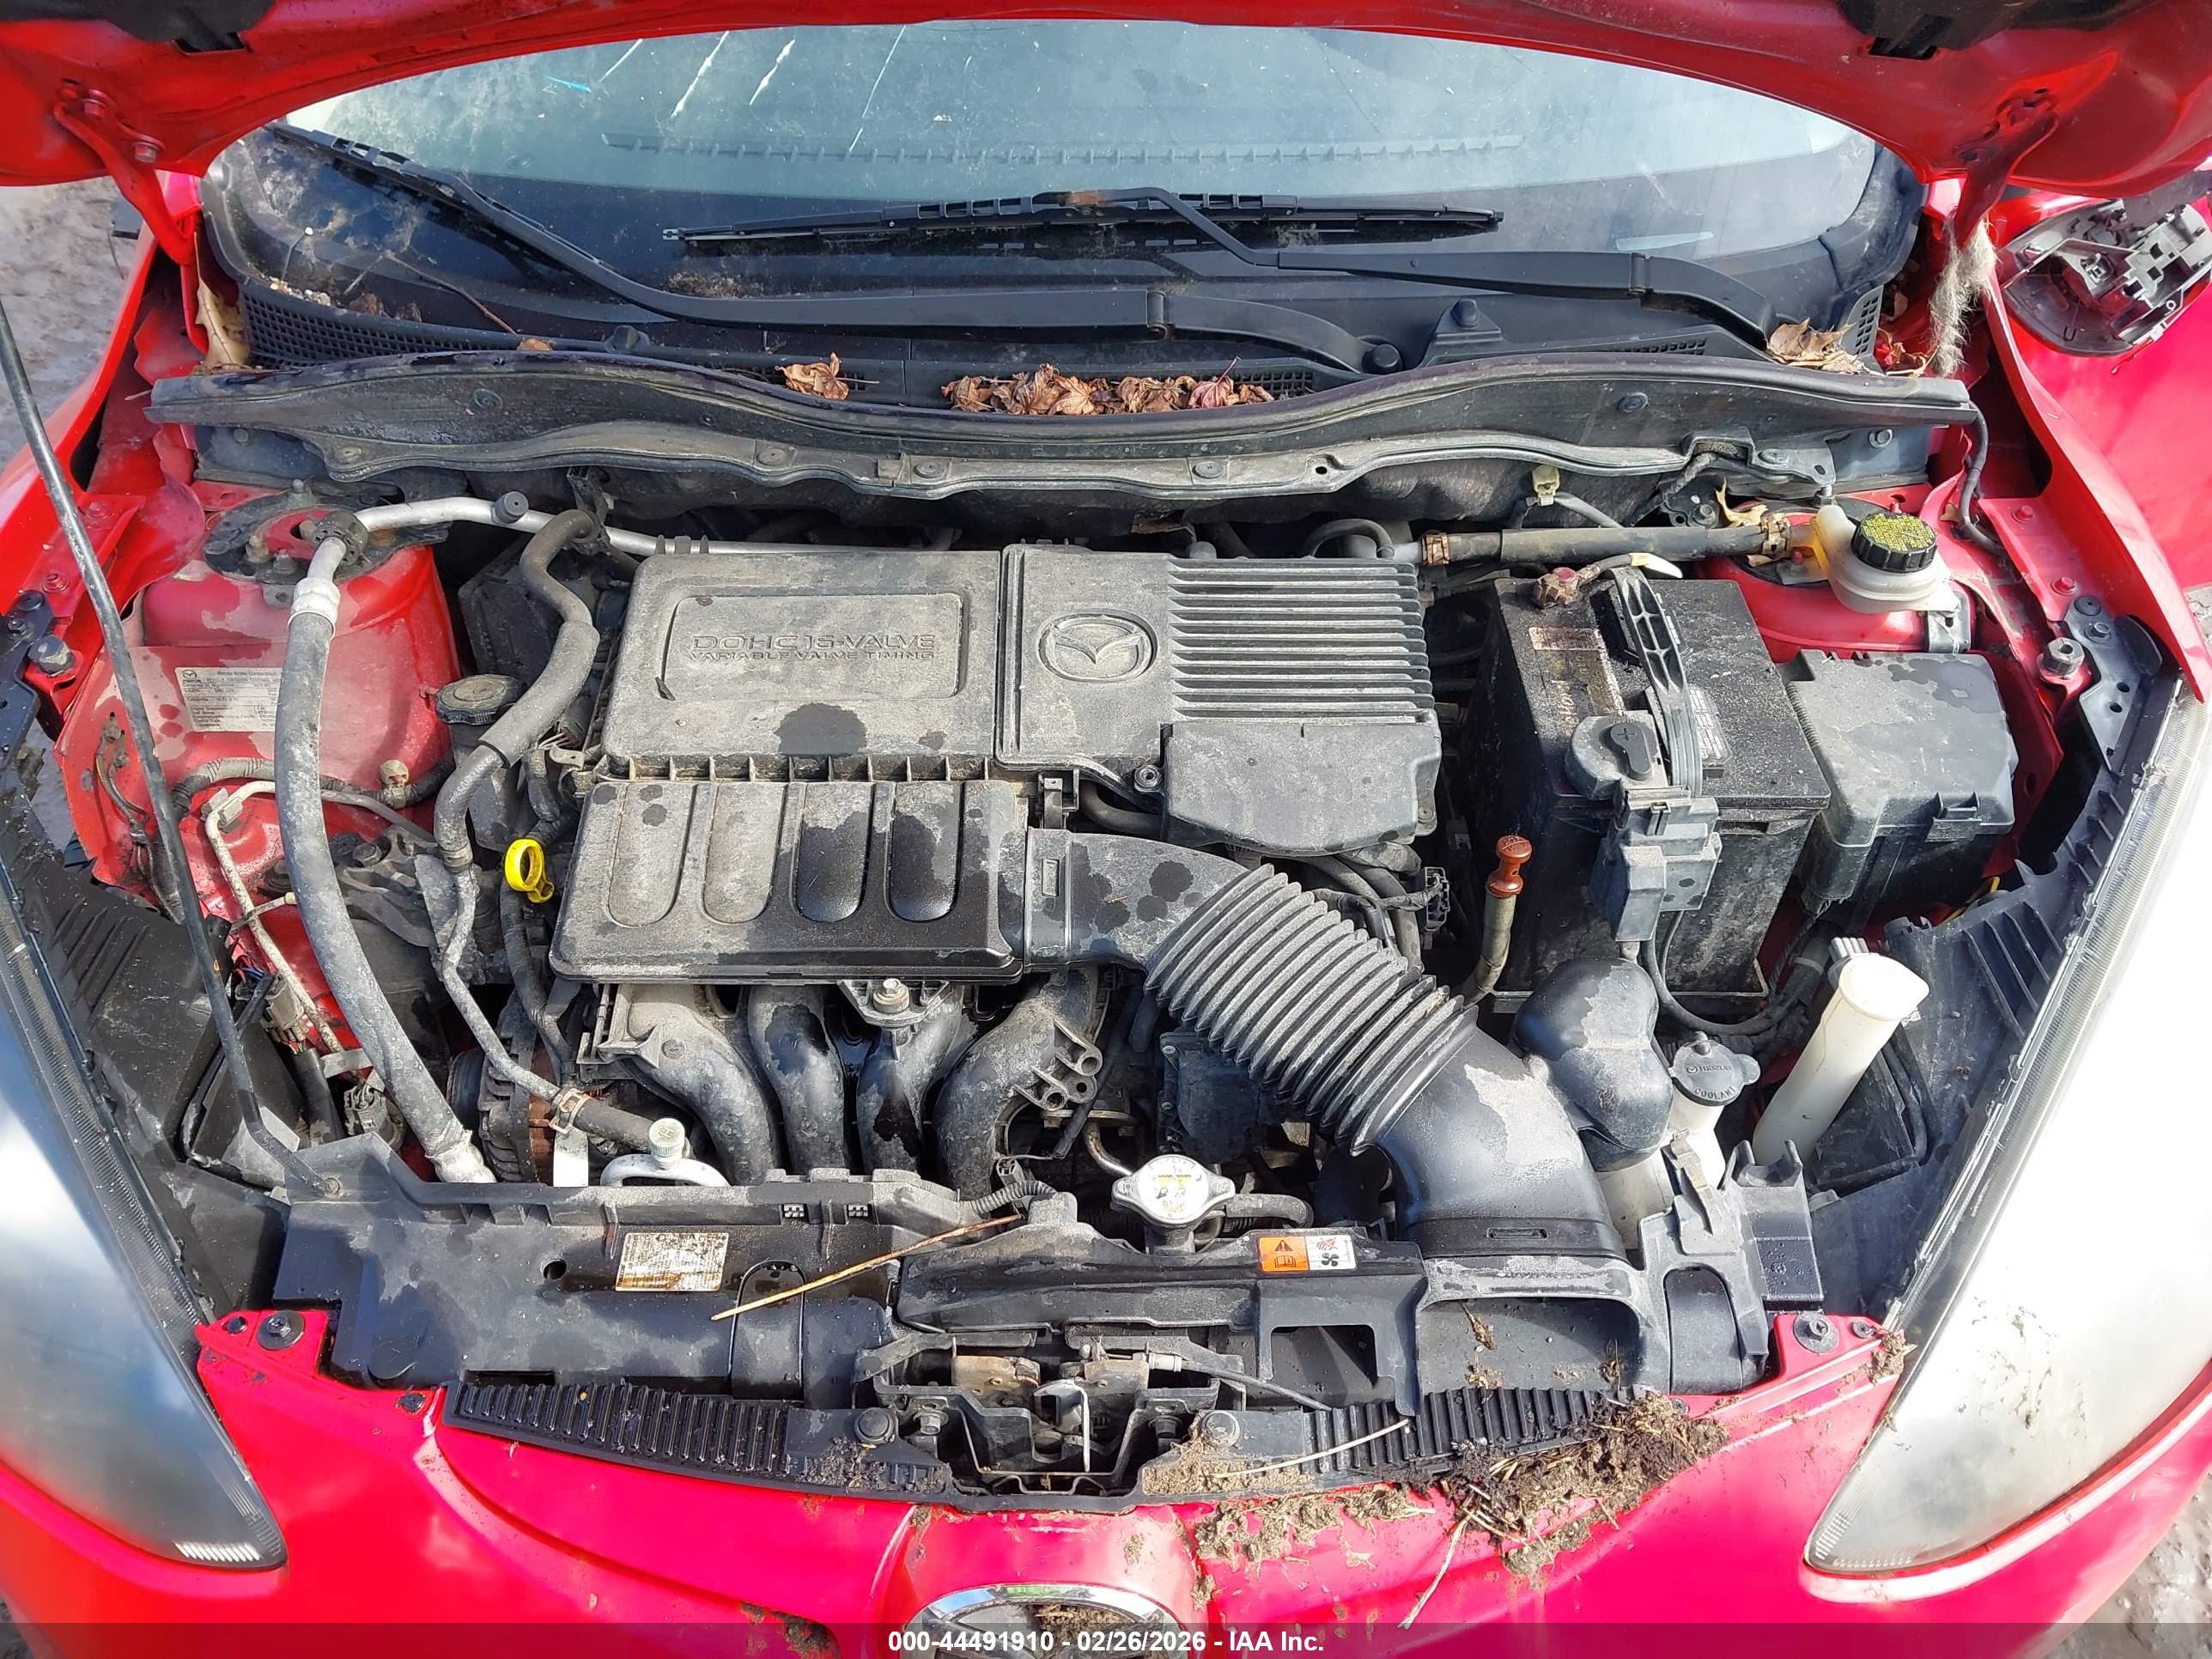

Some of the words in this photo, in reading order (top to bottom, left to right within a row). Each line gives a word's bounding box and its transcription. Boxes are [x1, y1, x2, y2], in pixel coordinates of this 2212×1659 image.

[692, 635, 798, 649] DOHC
[688, 651, 790, 660] VARIABLE
[794, 651, 857, 660] VALVE
[866, 651, 934, 659] TIMING
[1695, 1086, 1736, 1099] COOLANT
